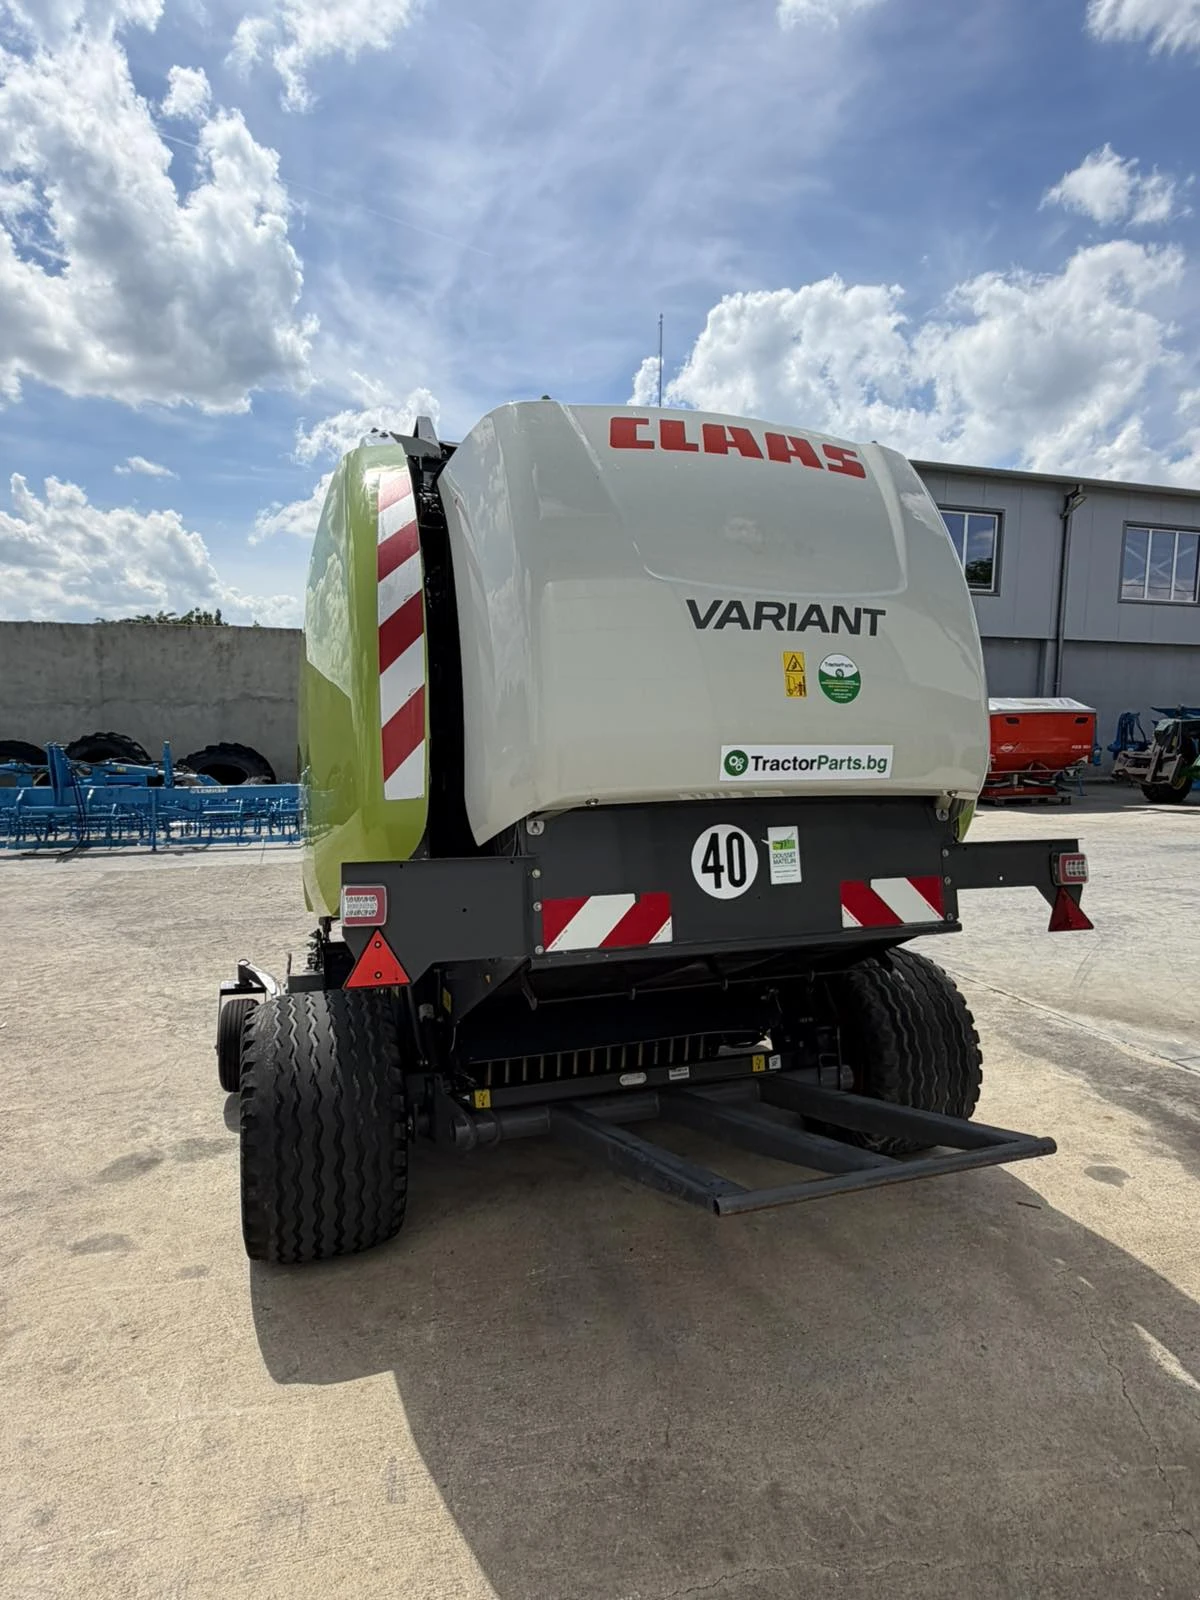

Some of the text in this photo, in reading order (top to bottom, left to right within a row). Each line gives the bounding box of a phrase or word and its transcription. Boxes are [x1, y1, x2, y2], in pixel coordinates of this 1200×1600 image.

[609, 416, 867, 479] CLAAS
[686, 599, 886, 636] VARIANT
[751, 755, 888, 773] TractorParts.bg
[701, 832, 747, 889] 40
